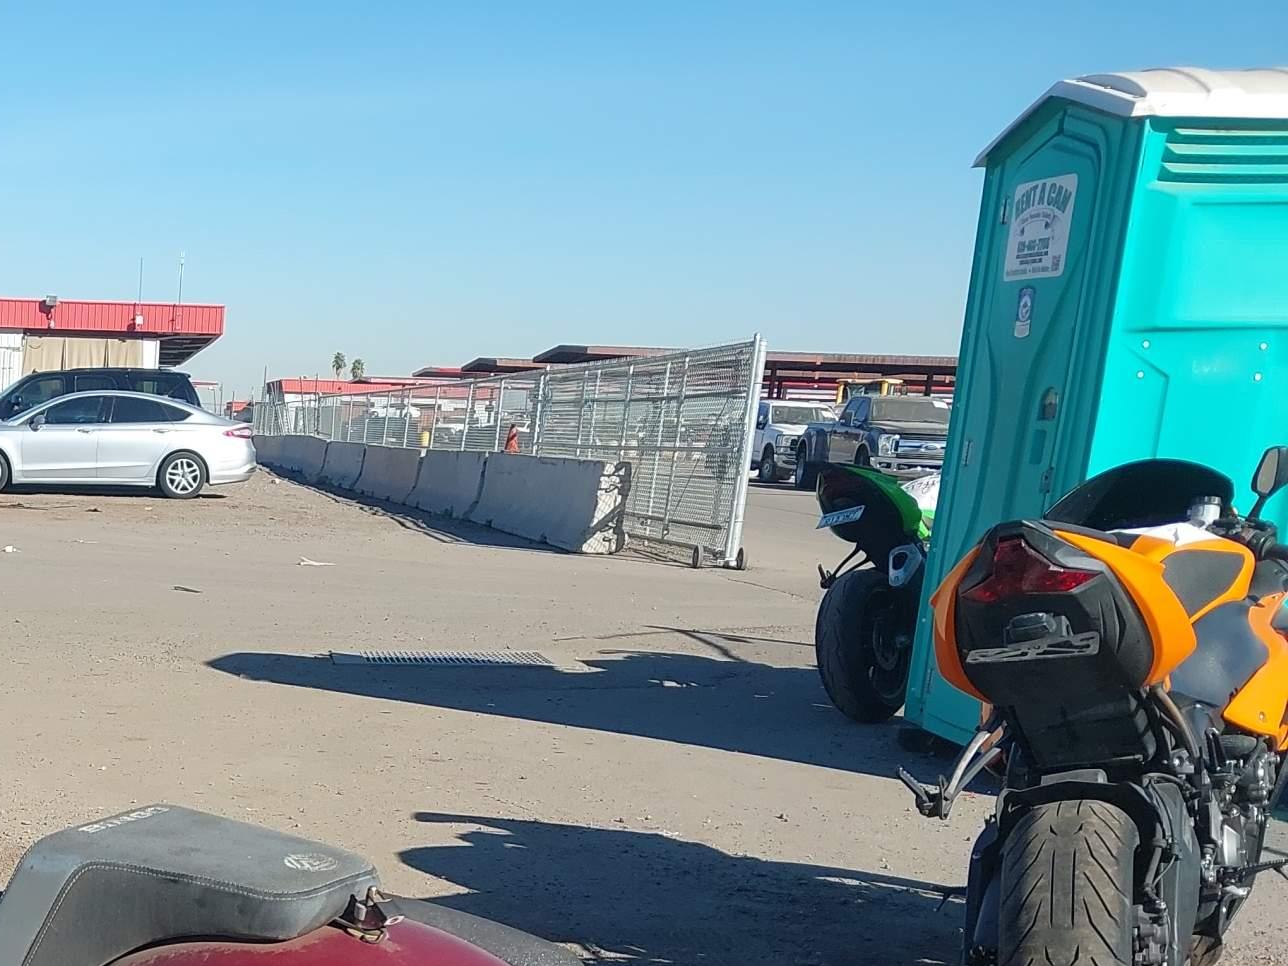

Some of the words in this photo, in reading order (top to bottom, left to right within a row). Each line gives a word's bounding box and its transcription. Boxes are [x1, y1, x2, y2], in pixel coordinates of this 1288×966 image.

[1015, 184, 1040, 221] RENT
[1037, 182, 1048, 206] A
[1047, 182, 1073, 214] CAN
